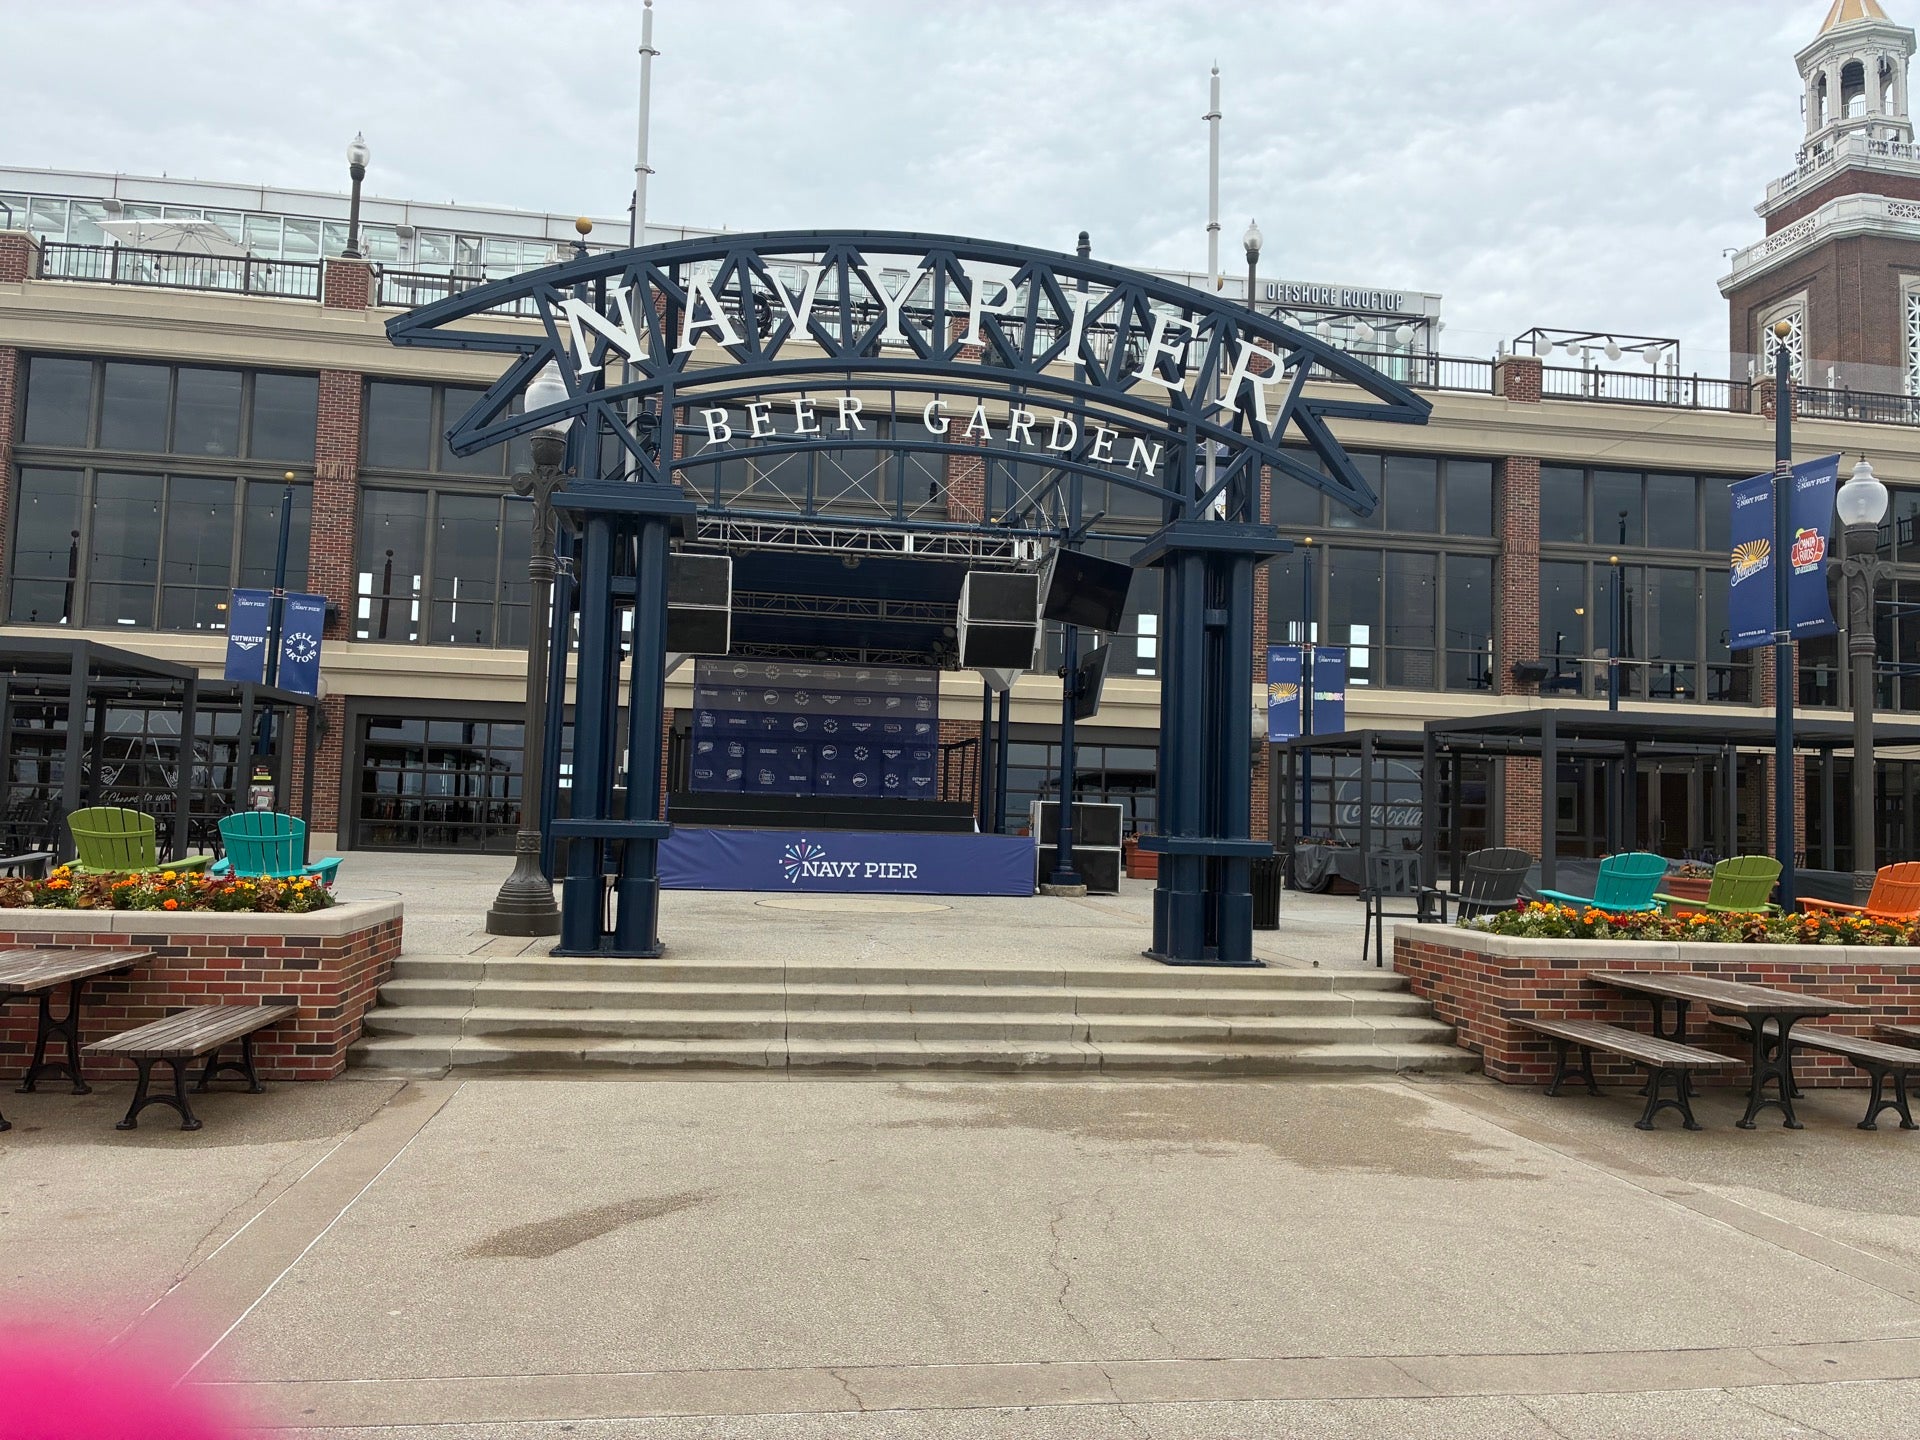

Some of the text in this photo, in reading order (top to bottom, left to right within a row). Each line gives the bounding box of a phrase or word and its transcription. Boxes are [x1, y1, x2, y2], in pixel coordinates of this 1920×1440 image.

[1267, 282, 1404, 312] OFFSHORE ROOFTOP
[558, 266, 1285, 426] NAVY PIER
[700, 396, 1165, 478] BEER GARDEN
[1801, 476, 1831, 490] NAVY PIER
[1740, 494, 1768, 507] NAVY PIER
[231, 635, 264, 643] CUTWATER
[286, 632, 317, 648] STELLA
[285, 648, 317, 663] ARTOIS
[801, 861, 918, 879] NAVY PIER
